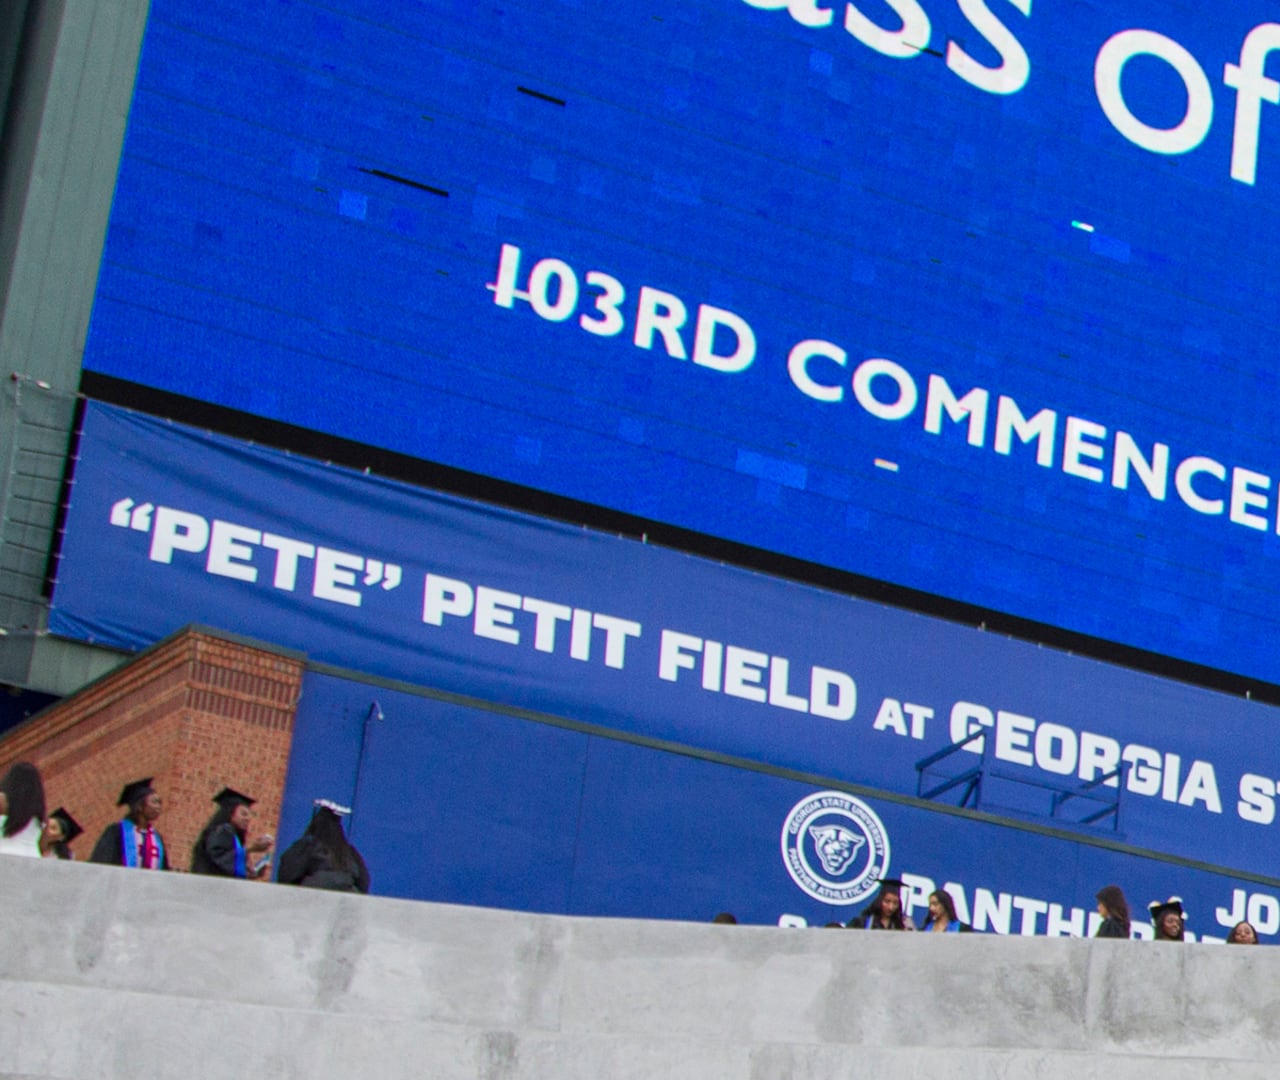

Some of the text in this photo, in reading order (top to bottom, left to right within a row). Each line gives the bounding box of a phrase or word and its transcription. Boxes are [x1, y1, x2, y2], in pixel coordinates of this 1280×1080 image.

[485, 243, 757, 373] 103RD
[422, 573, 642, 669] PETIT
[658, 628, 857, 721] FIELD
[872, 696, 935, 741] AT
[949, 700, 1223, 815] GEORGIA
[788, 848, 818, 890] PANTHER
[817, 886, 863, 899] ATHLETIC
[789, 798, 884, 856] GEORGIA STATE UNIVERSITY
